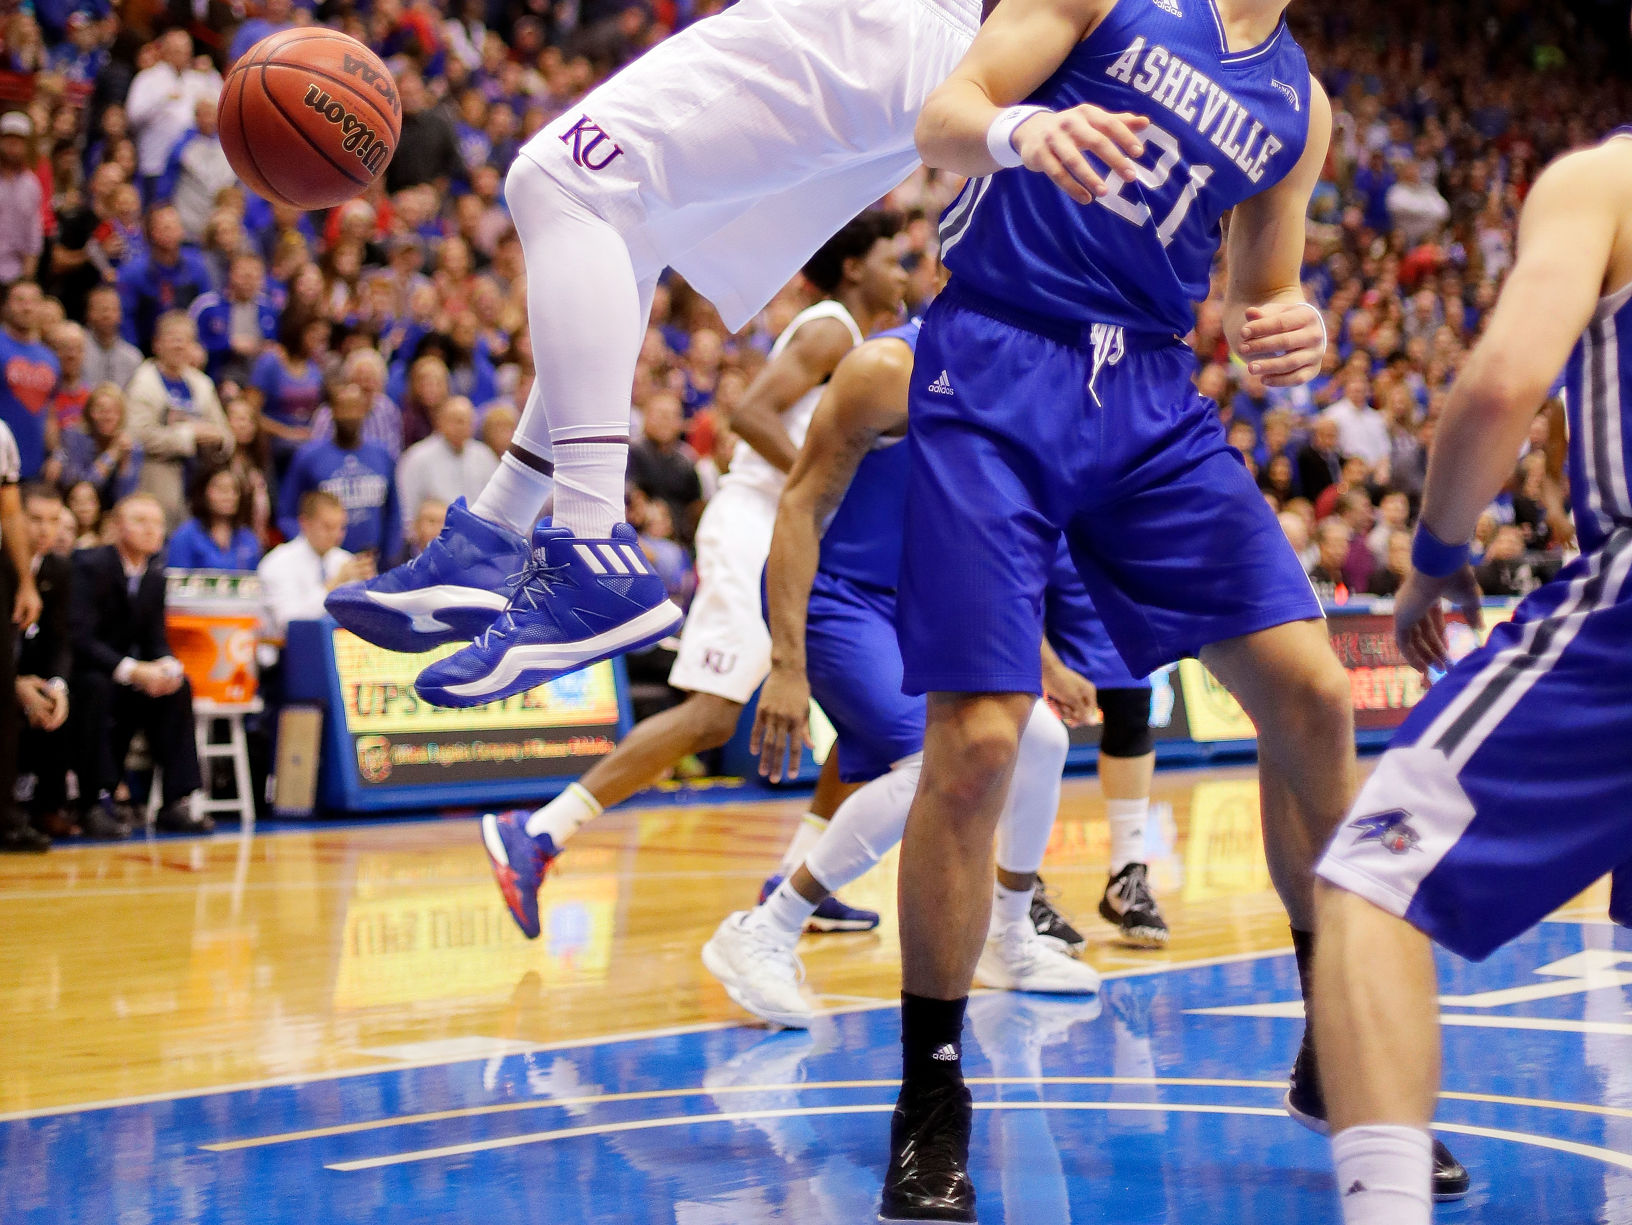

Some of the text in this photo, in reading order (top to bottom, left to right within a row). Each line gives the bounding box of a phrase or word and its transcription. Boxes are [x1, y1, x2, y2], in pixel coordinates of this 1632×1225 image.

[303, 83, 390, 177] Wilson
[1105, 35, 1284, 184] ASHEVILLE
[558, 113, 624, 171] KU
[1094, 121, 1214, 249] 21
[928, 384, 954, 395] adidas
[701, 646, 738, 675] KU
[932, 1053, 959, 1061] adidas
